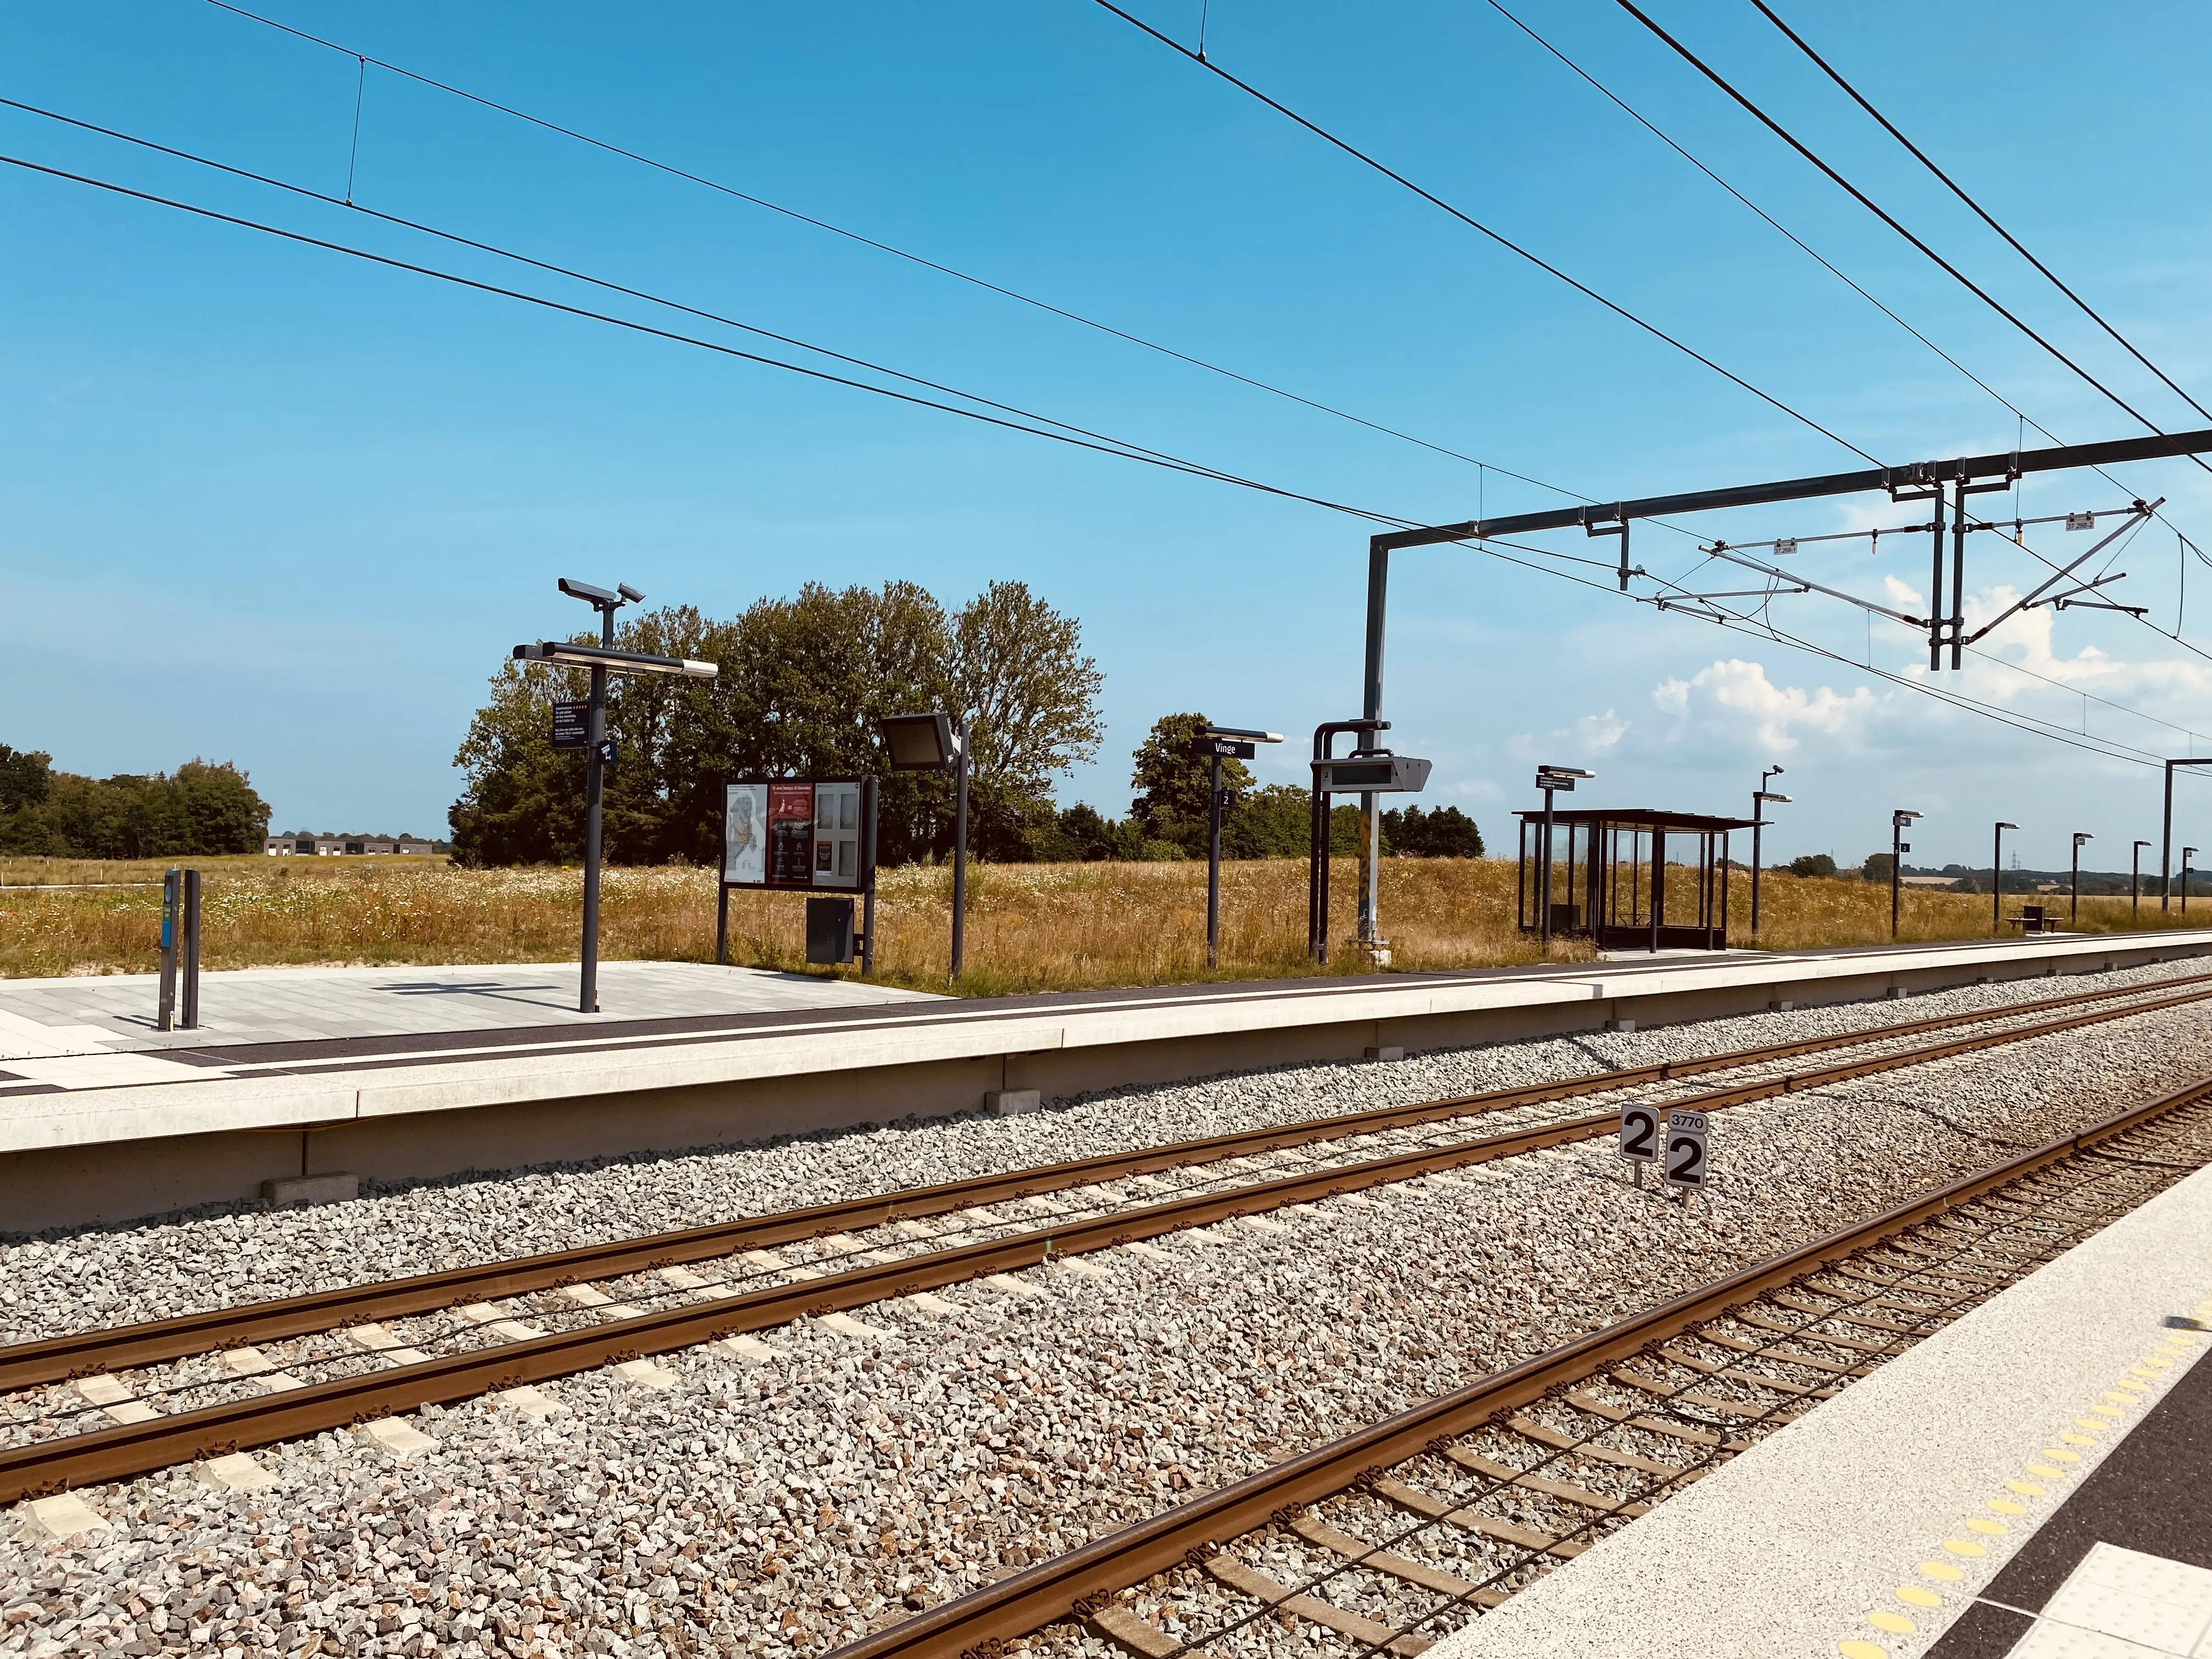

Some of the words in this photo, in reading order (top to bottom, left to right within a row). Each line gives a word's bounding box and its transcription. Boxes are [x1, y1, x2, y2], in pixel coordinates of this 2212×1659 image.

[1215, 742, 1235, 755] Vinge
[1223, 795, 1229, 804] 2
[1672, 1114, 1703, 1129] 3770
[1624, 1111, 1655, 1158] 2
[1669, 1137, 1702, 1184] 2
